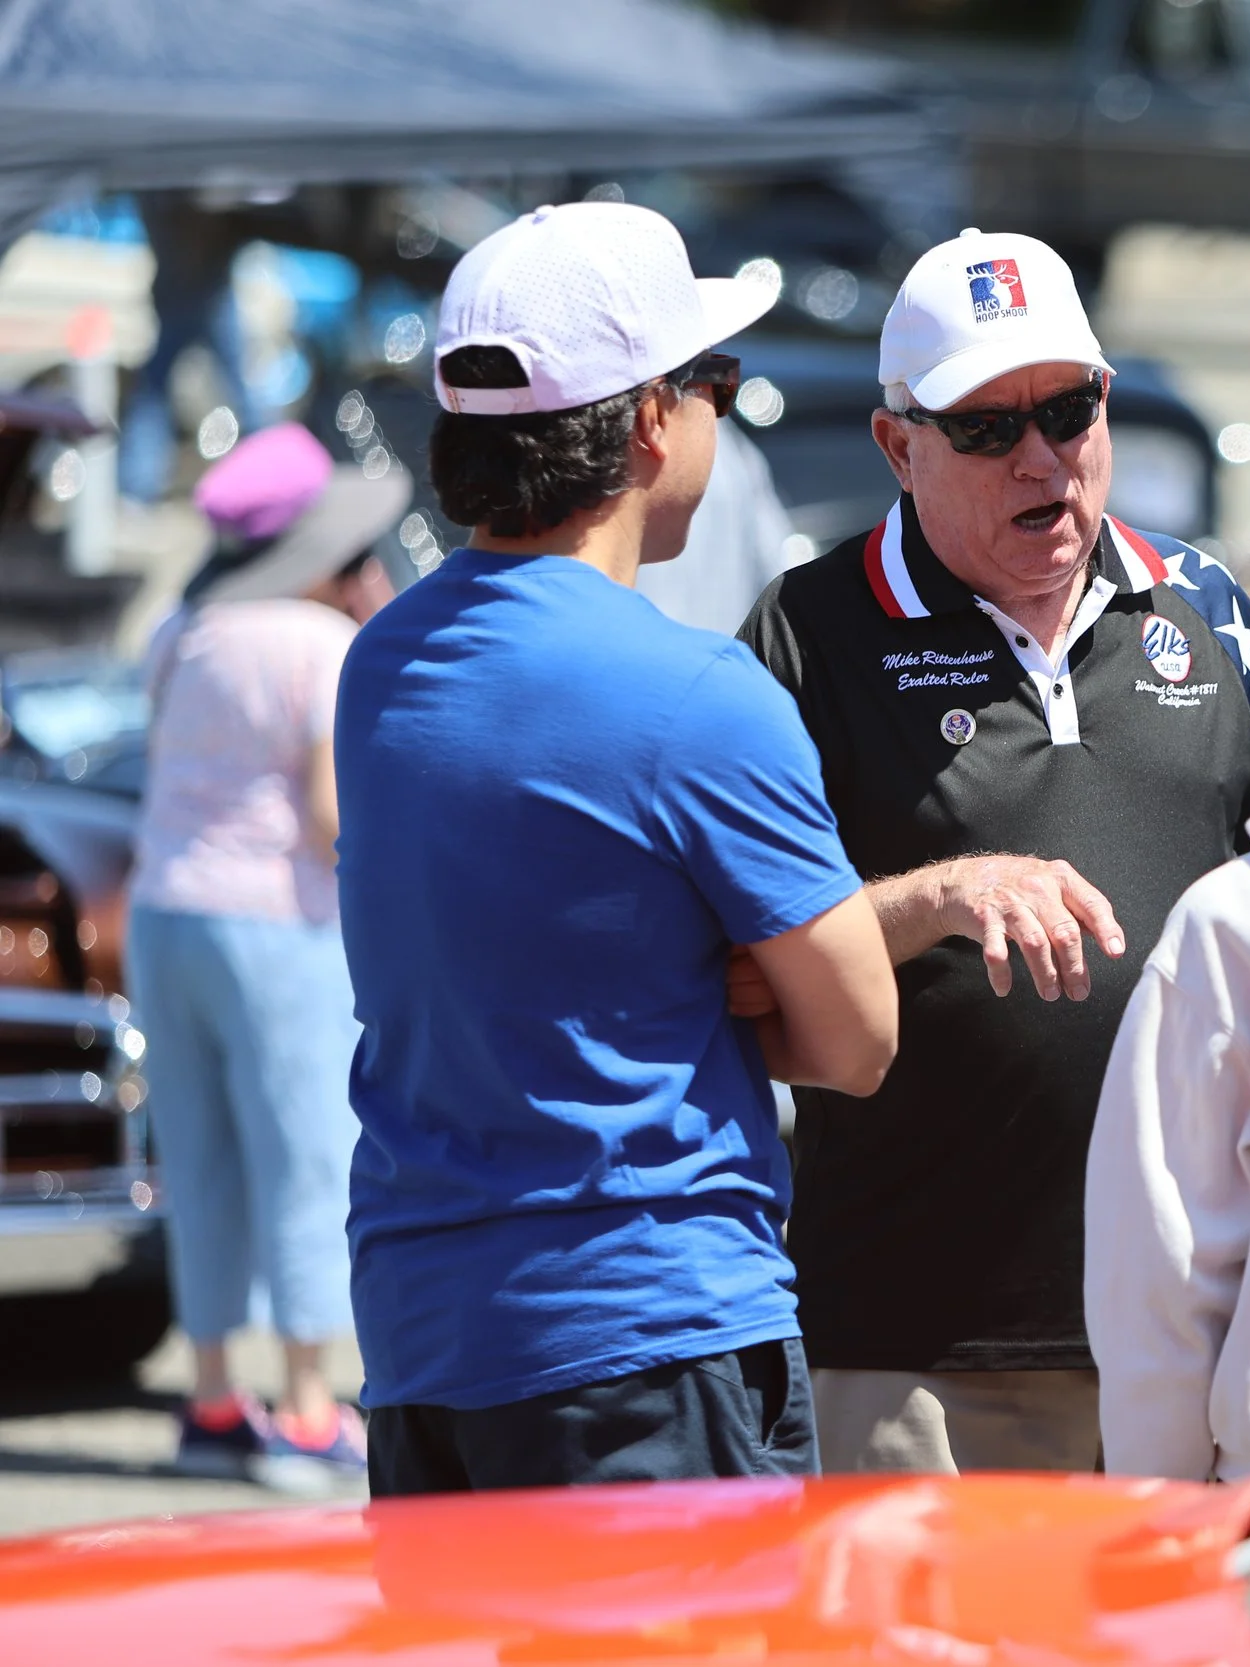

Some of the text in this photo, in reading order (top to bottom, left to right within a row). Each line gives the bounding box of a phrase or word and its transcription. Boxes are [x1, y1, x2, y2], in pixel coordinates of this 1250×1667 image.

[975, 299, 998, 313] ELKS
[976, 307, 1028, 324] HOOP SHOOT
[1142, 621, 1191, 661] Elks
[882, 650, 995, 670] Mike Rittenhouse
[897, 671, 989, 691] Exalted Ruler
[1157, 694, 1202, 709] California
